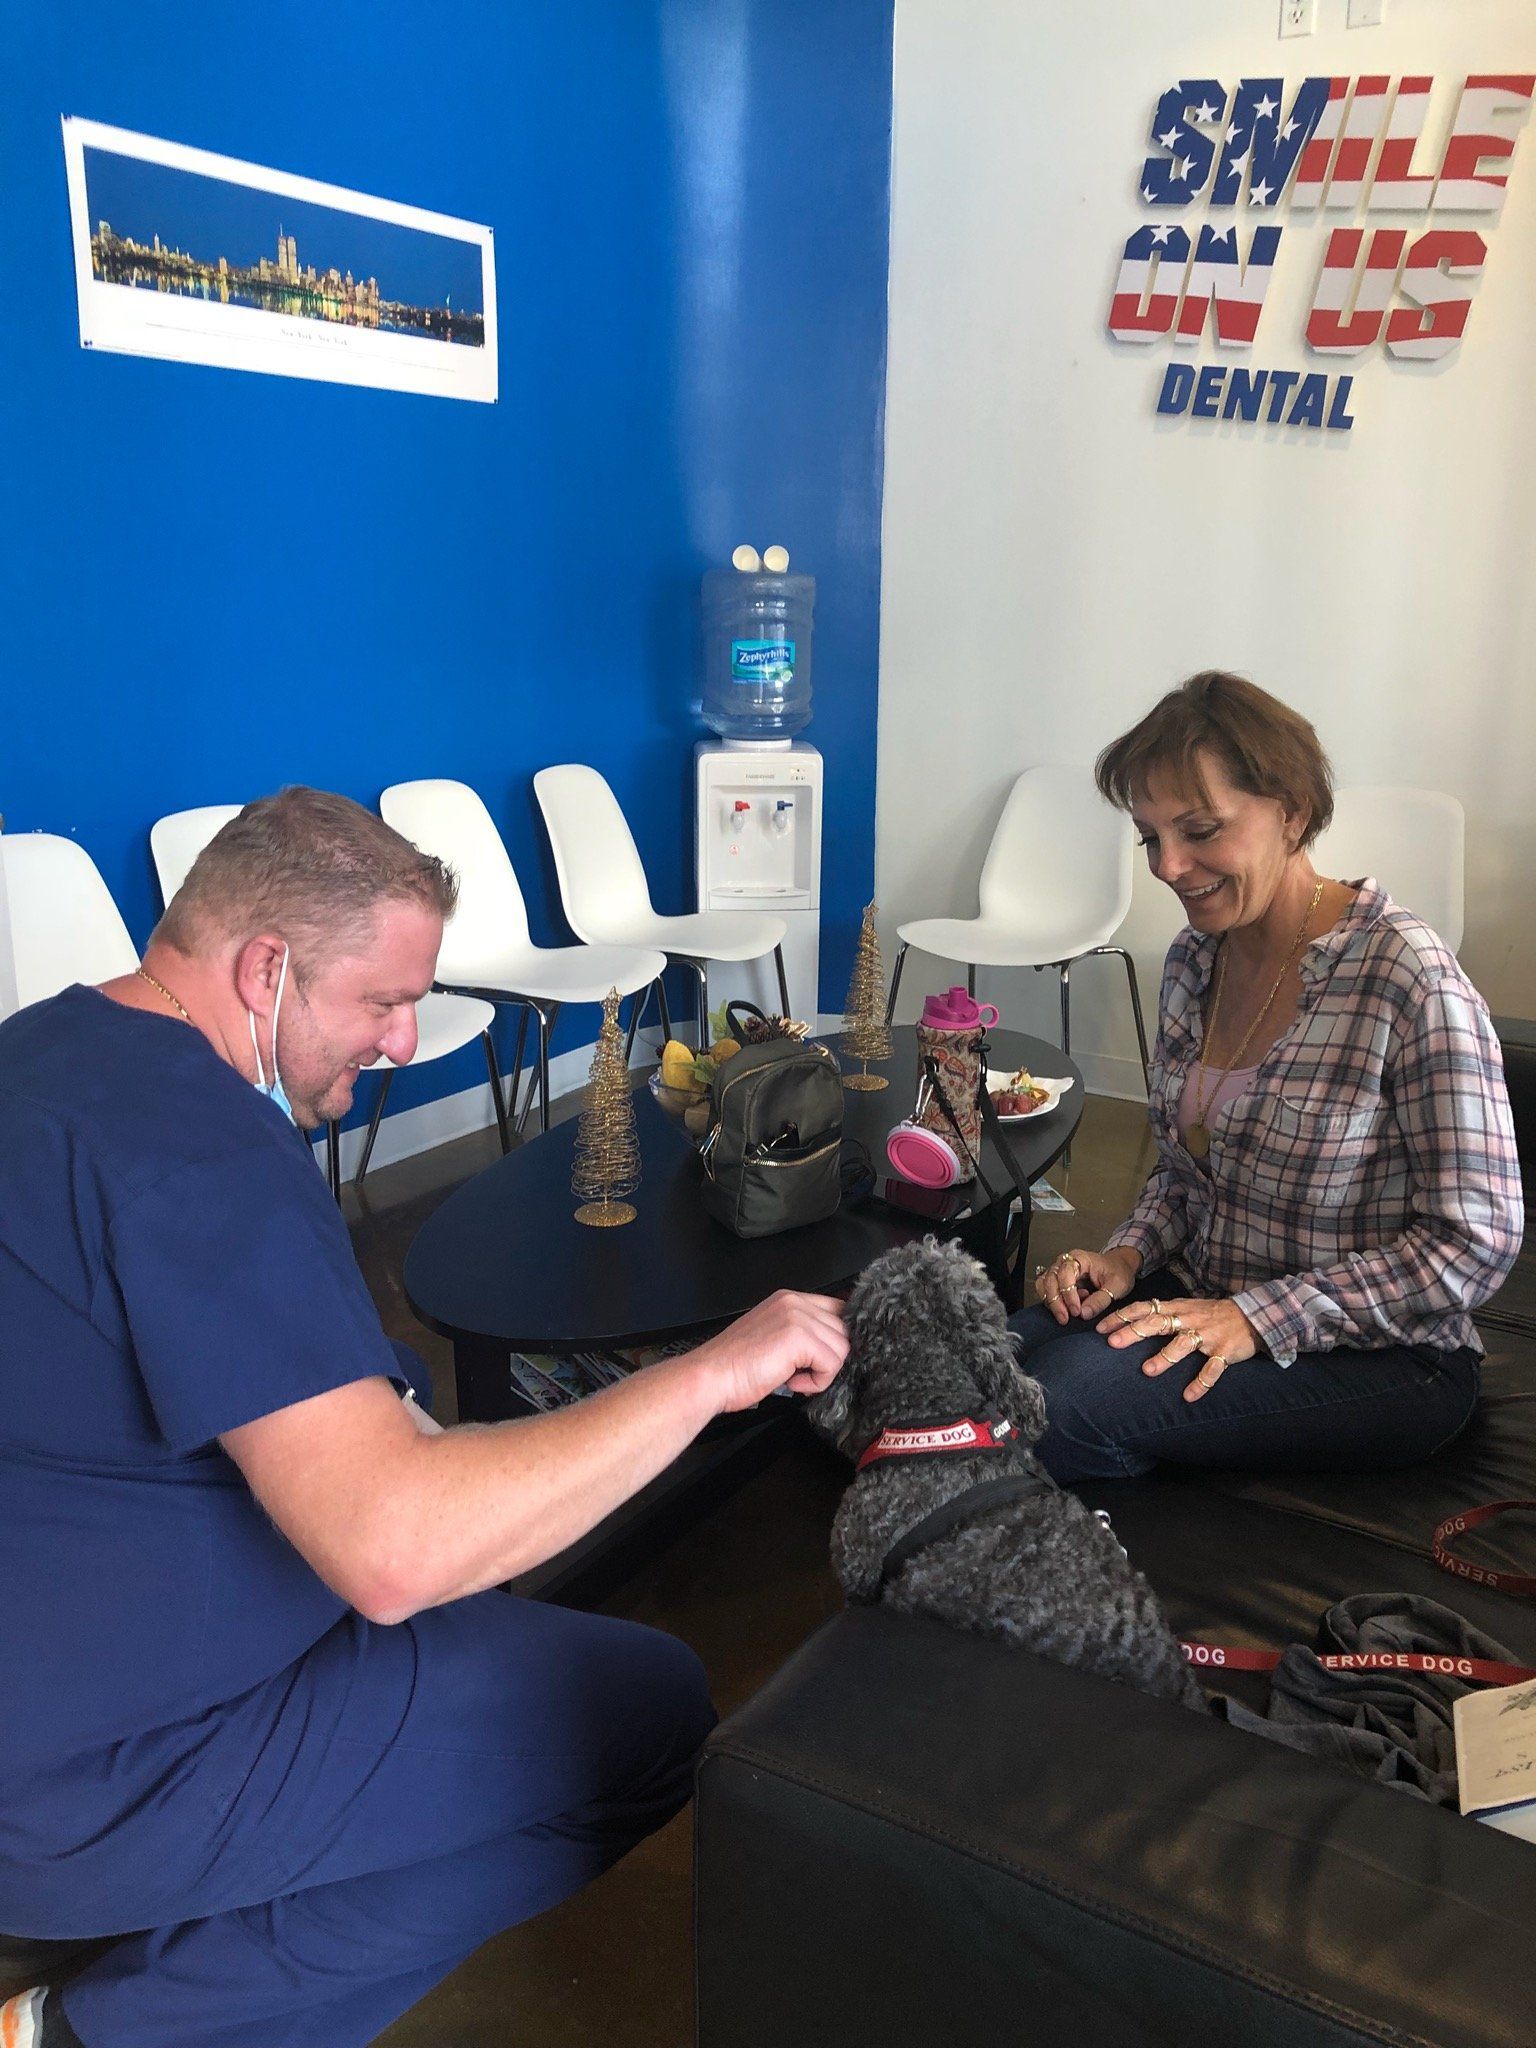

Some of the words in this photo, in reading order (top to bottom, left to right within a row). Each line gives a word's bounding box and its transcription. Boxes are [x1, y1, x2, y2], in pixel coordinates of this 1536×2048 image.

[1139, 75, 1536, 211] SMILE
[1108, 225, 1283, 348] ON
[1305, 228, 1488, 361] US
[1156, 363, 1354, 430] DENTAL
[739, 649, 789, 663] Zephyrhills
[880, 1434, 937, 1447] SERVICE
[941, 1427, 972, 1443] DOG
[1434, 1518, 1466, 1541] DOG
[1434, 1544, 1499, 1588] SERVIC
[1422, 1656, 1473, 1676] DOG
